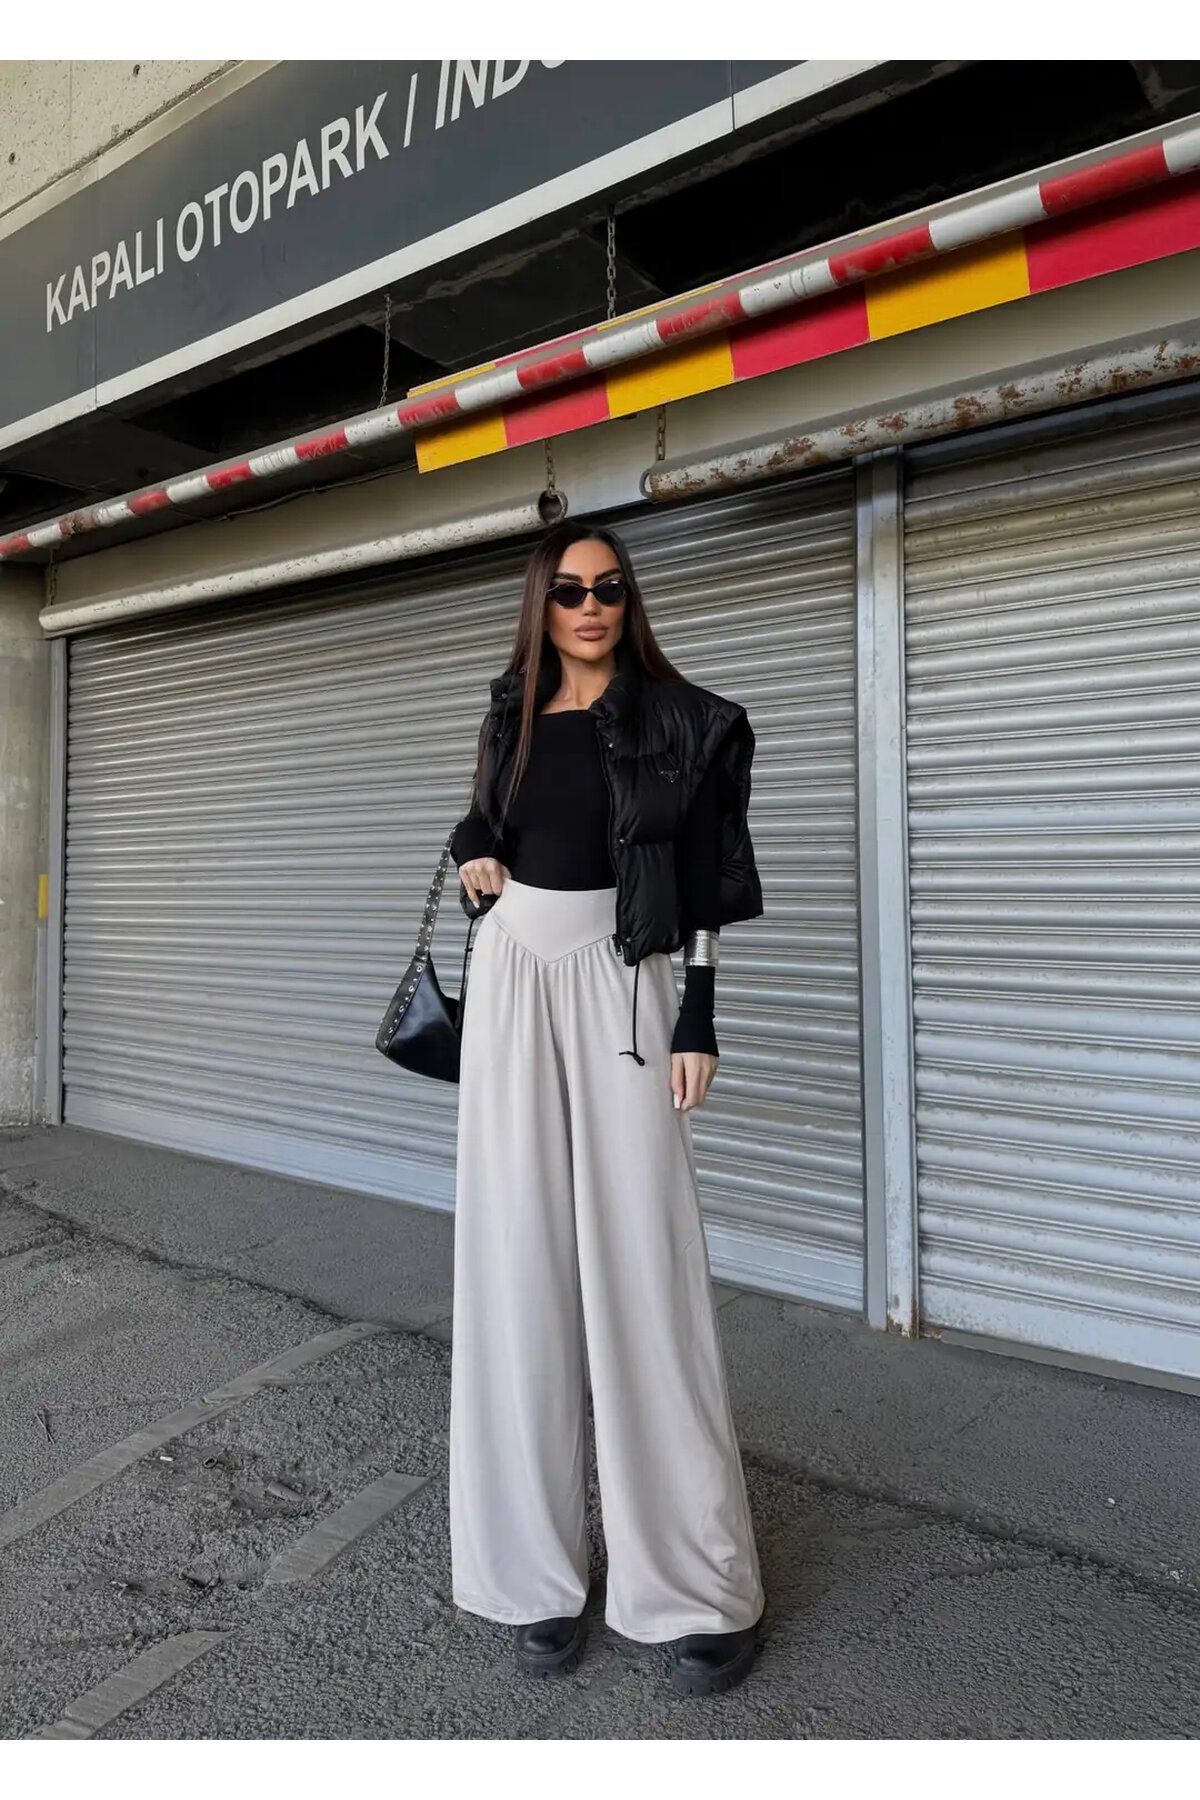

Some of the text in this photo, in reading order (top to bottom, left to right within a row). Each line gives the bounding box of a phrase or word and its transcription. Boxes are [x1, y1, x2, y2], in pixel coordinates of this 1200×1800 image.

[46, 217, 164, 333] KAPALI
[176, 91, 390, 263] OTOPARK
[403, 72, 418, 148] /
